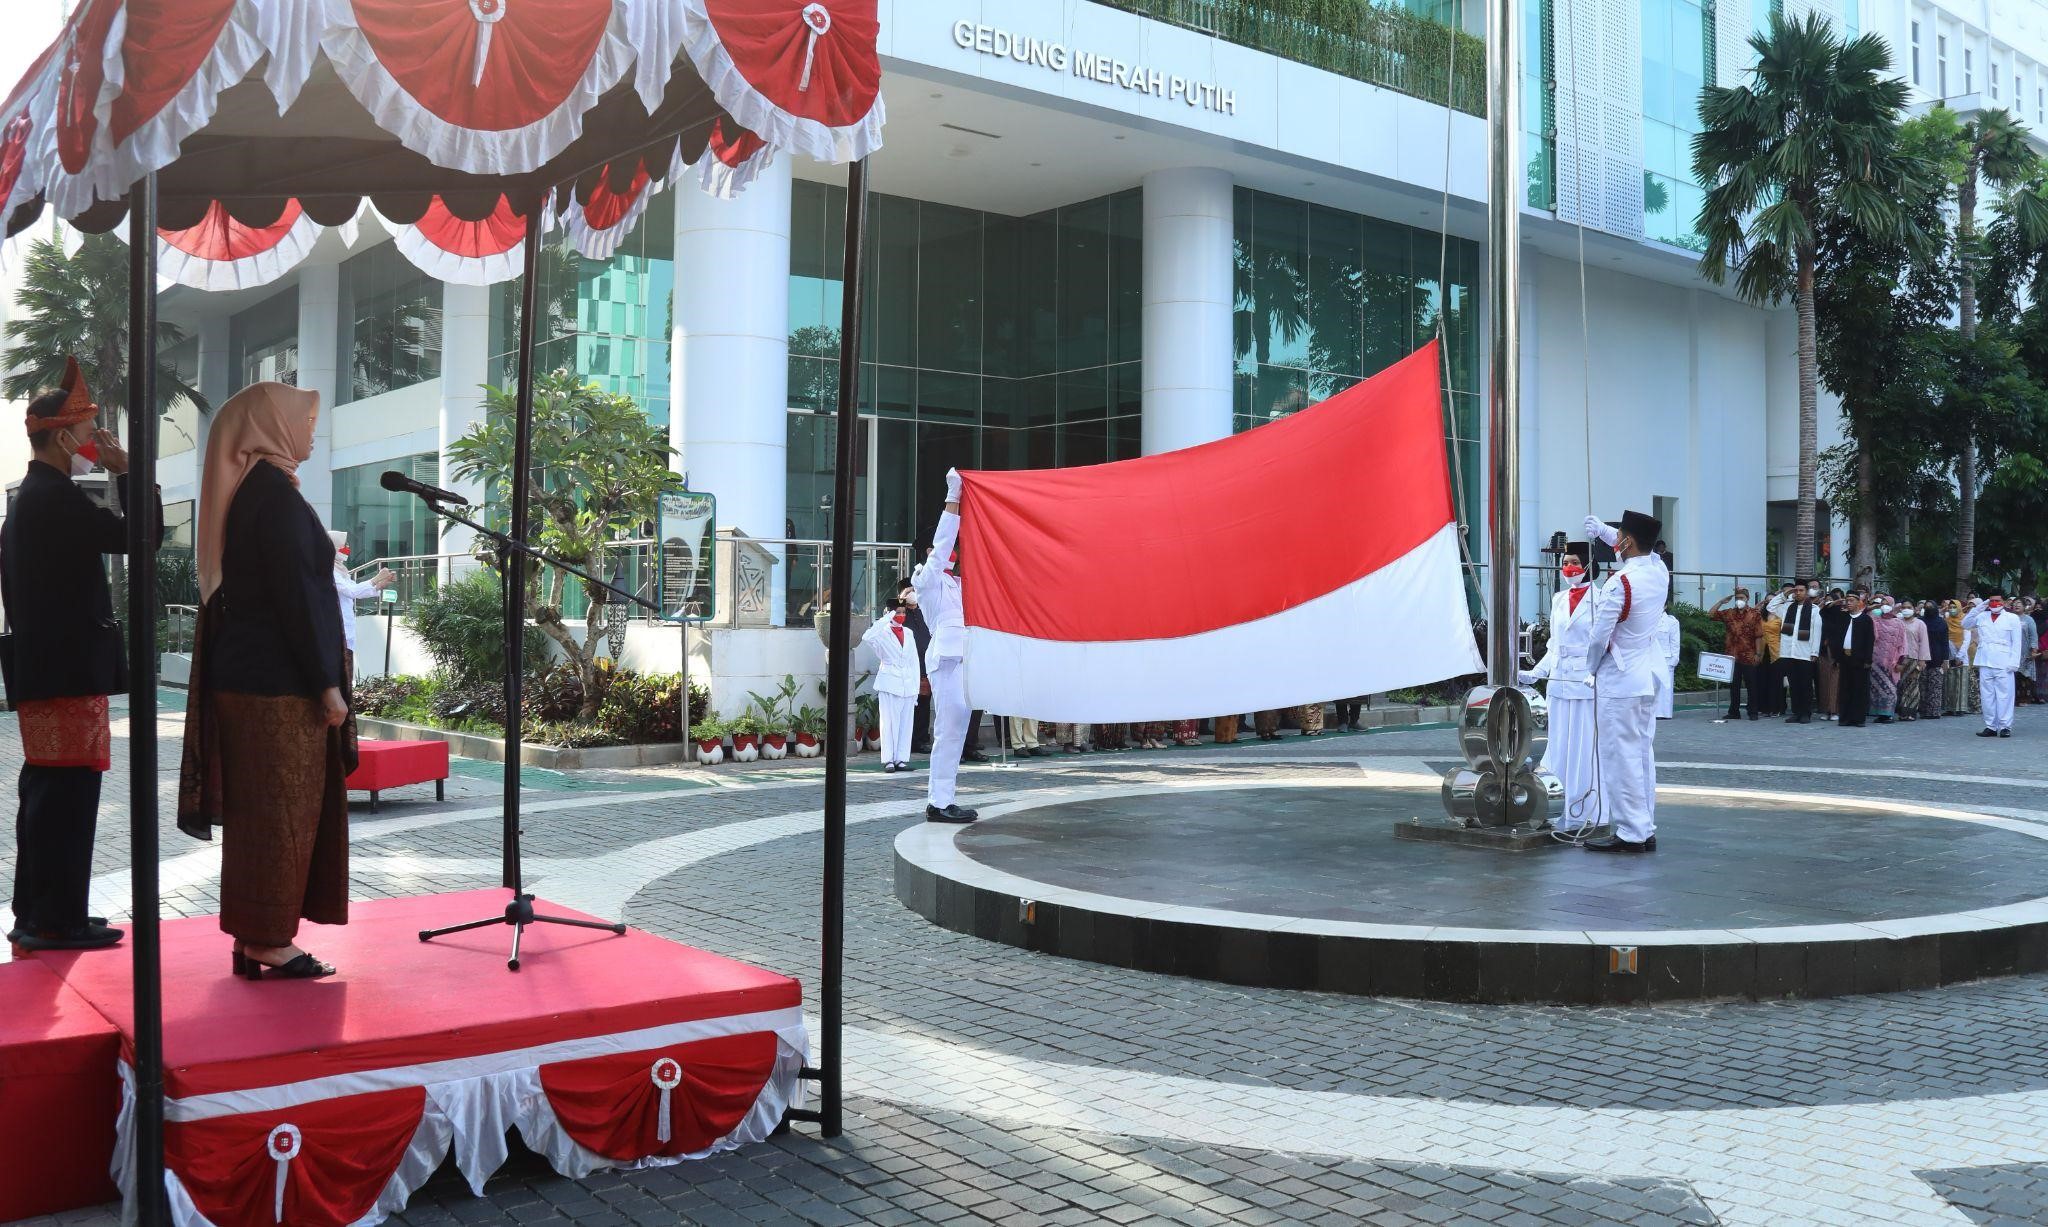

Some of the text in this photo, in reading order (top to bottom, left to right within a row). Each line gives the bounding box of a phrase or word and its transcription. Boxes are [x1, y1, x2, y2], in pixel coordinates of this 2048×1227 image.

[953, 19, 1236, 115] GEDUNG MERAH PUTIH
